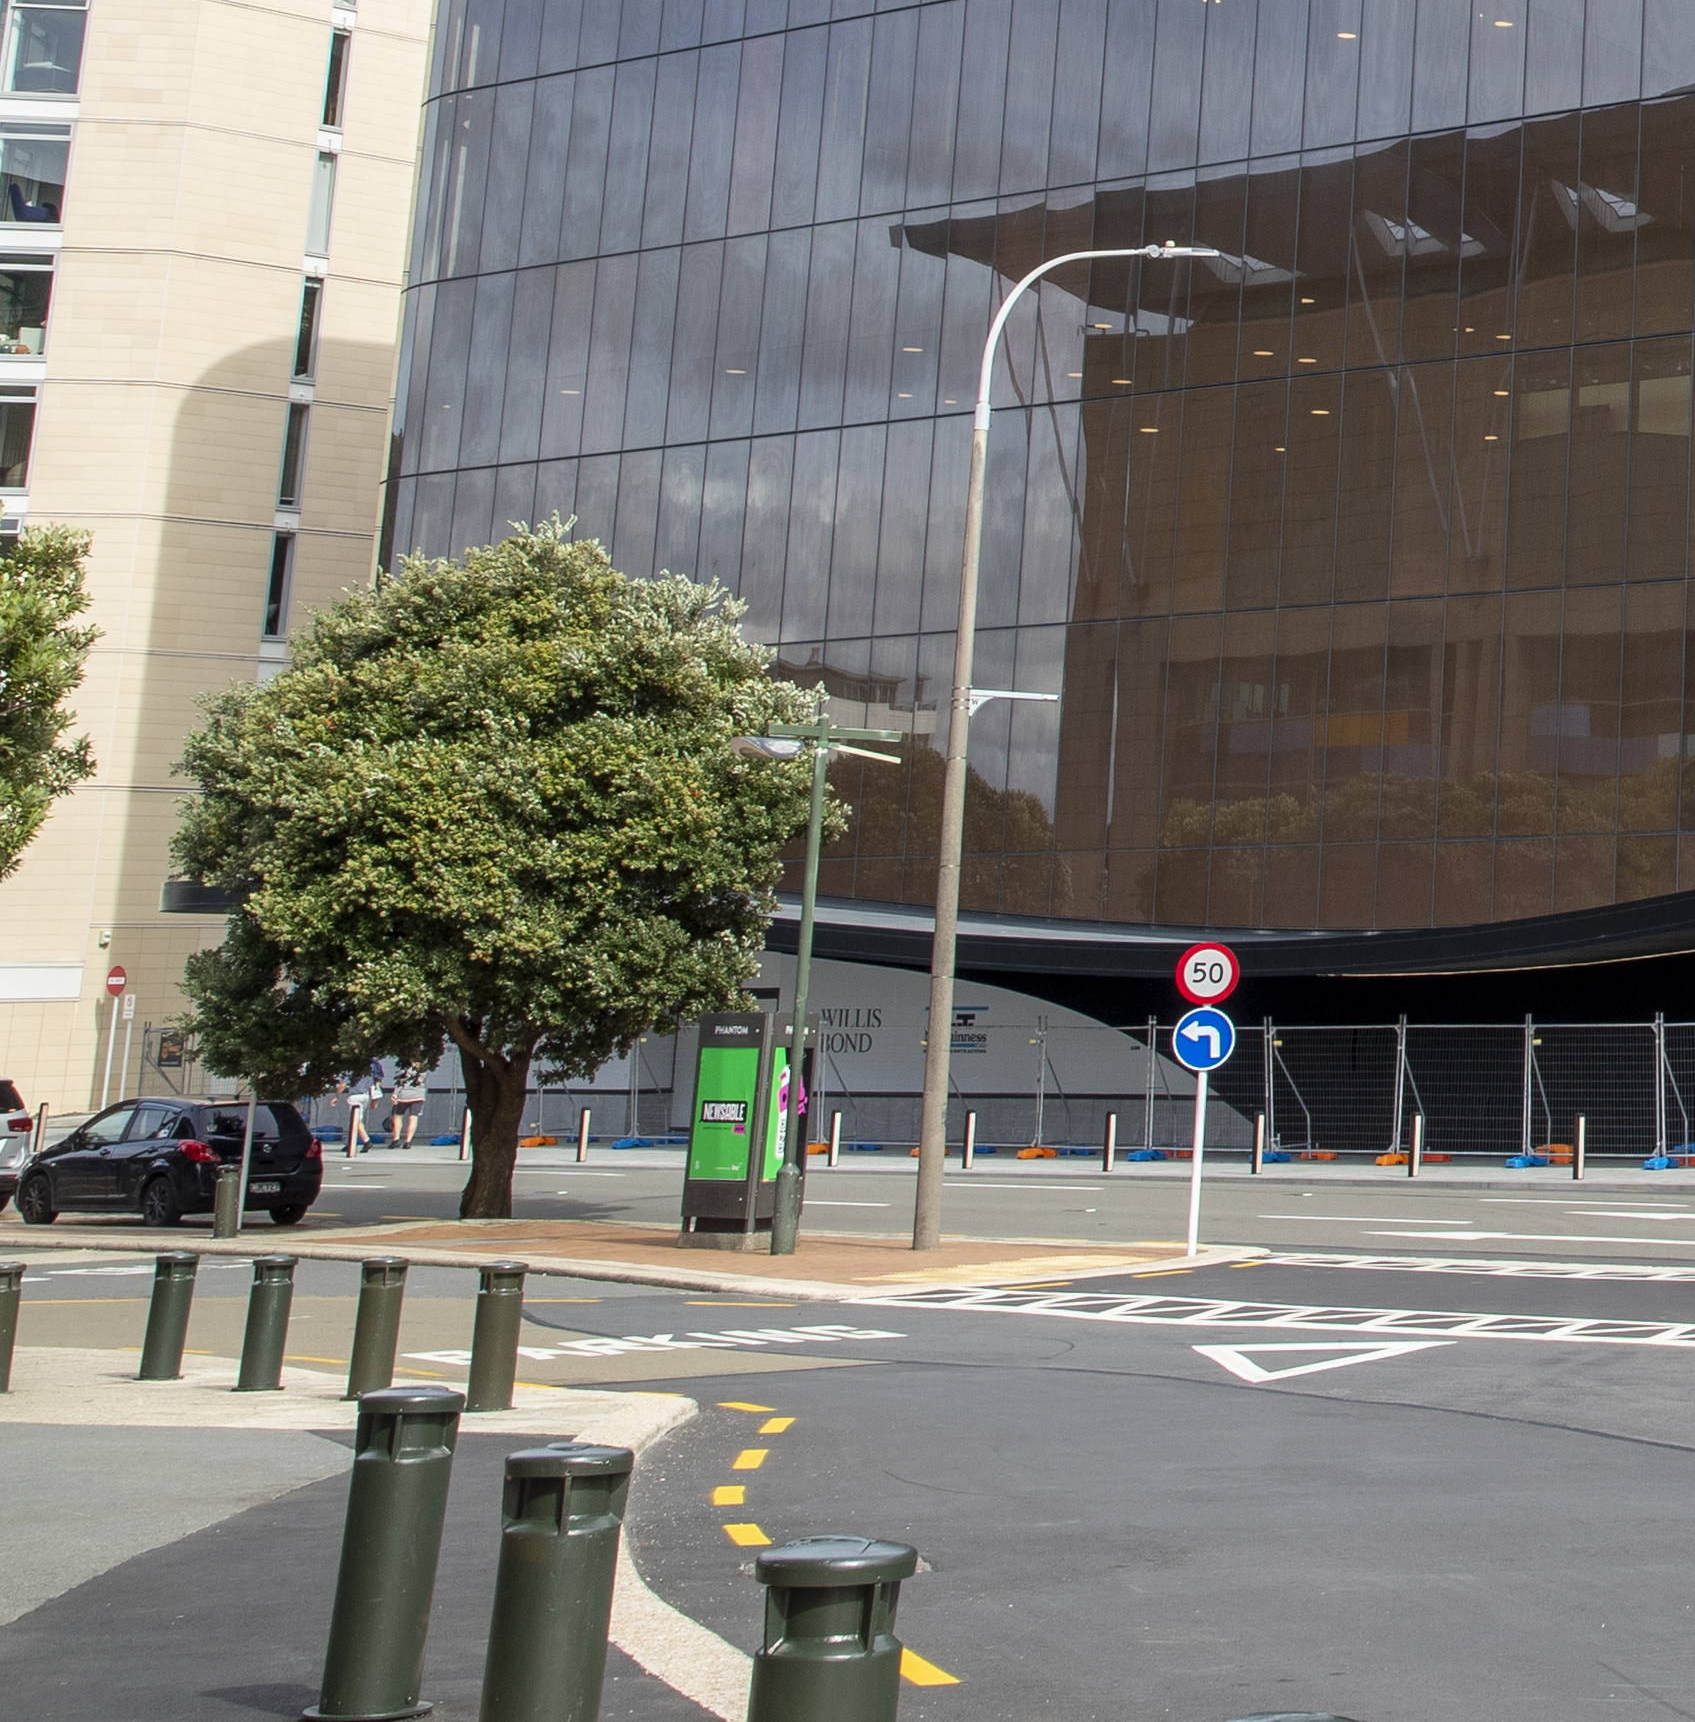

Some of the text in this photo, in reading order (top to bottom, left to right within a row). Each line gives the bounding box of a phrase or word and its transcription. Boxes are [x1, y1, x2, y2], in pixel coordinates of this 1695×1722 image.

[1192, 962, 1224, 983] 50
[821, 1008, 882, 1028] WILLIS
[714, 1026, 749, 1035] PHANTOM
[820, 1033, 872, 1053] BOND
[703, 1102, 746, 1122] NEWSABLE
[402, 1324, 908, 1366] PARKING
